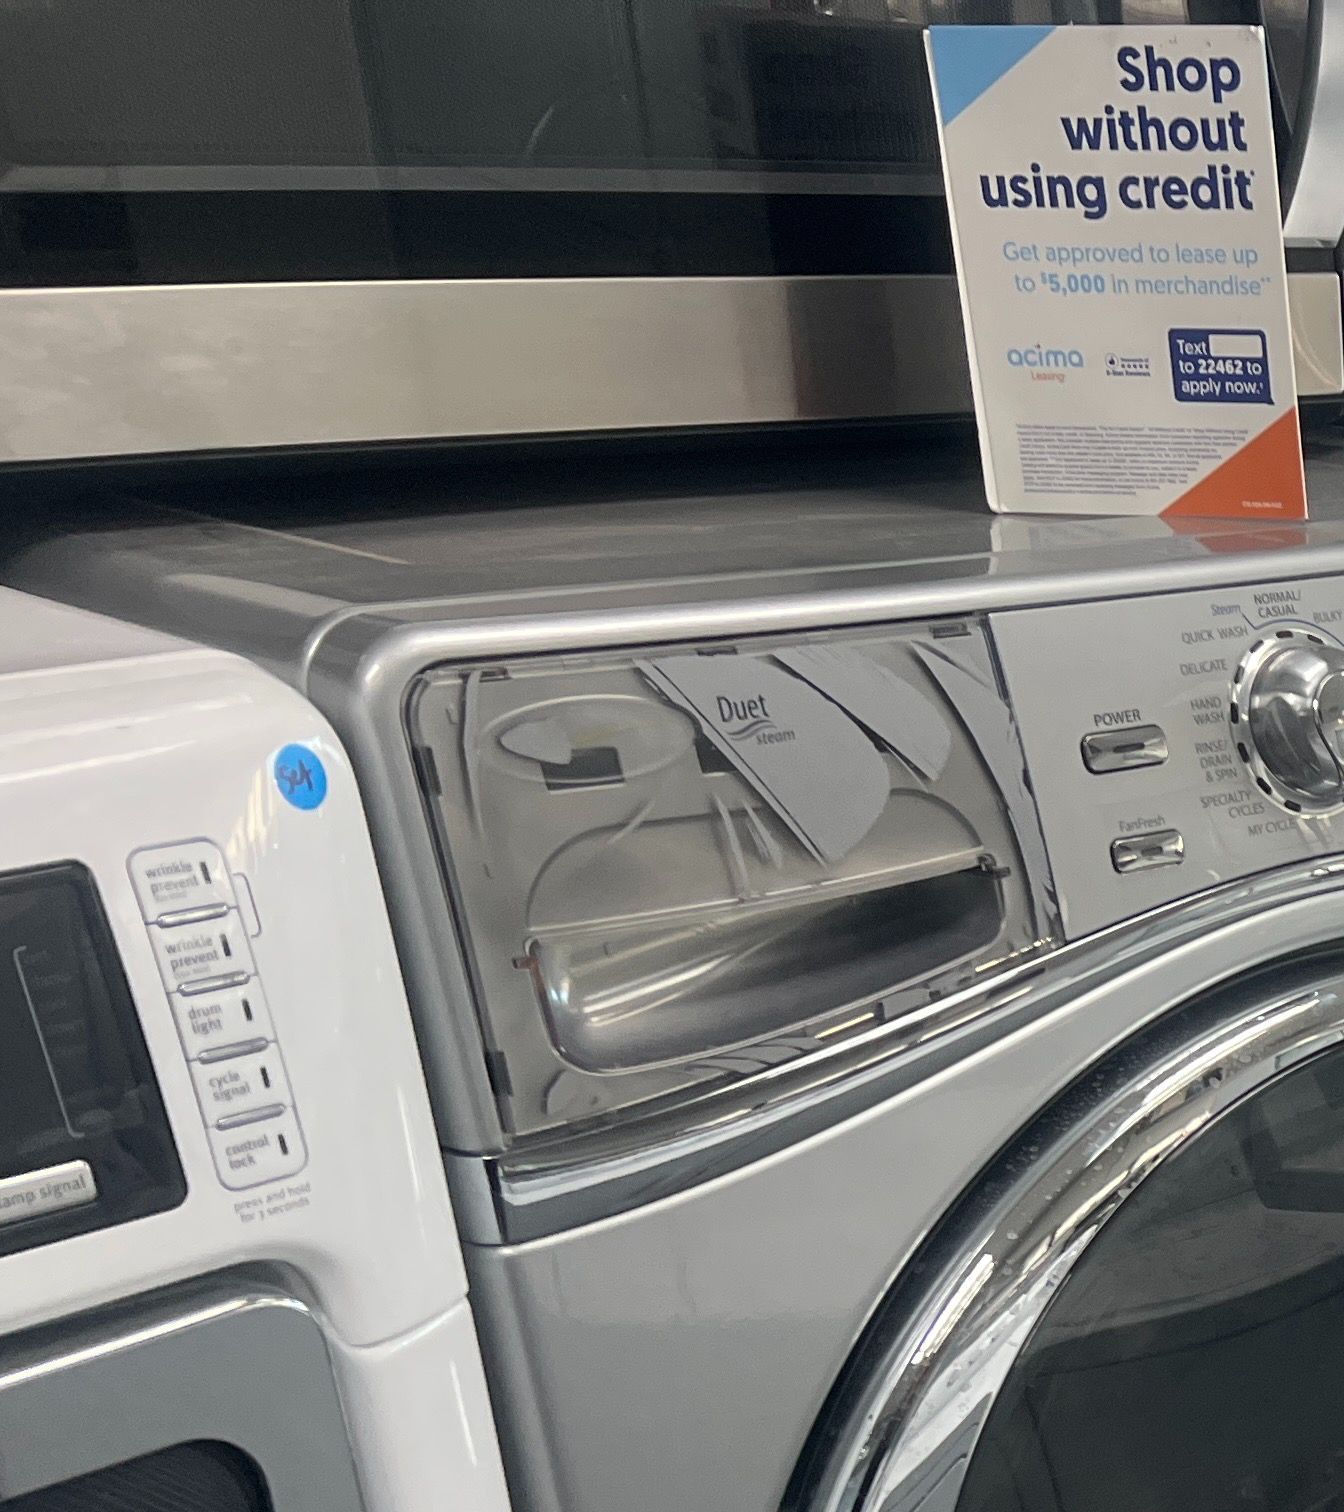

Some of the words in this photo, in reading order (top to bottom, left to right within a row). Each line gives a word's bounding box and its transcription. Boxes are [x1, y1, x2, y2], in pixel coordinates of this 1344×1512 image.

[1117, 45, 1241, 103] Shop
[1060, 104, 1248, 151] without
[979, 162, 1107, 219] using
[1002, 241, 1039, 262] Get
[1045, 243, 1144, 267] approved
[1149, 245, 1170, 263] to
[1175, 243, 1226, 263] lease
[1233, 248, 1258, 268] up
[1015, 273, 1036, 293] to
[1041, 271, 1105, 297] $5,000
[1111, 273, 1129, 293] in
[1007, 344, 1085, 368] acima
[1176, 338, 1209, 356] Text
[1178, 358, 1195, 374] to
[1198, 359, 1243, 375] 22462
[1246, 359, 1262, 375] to
[1030, 372, 1066, 384] Leasing
[1181, 379, 1221, 397] apply
[1210, 604, 1241, 617] Steam
[1258, 604, 1299, 619] CASUAL
[1313, 609, 1342, 623] BULKY
[1181, 629, 1215, 644] QUICK
[1218, 626, 1248, 640] WASH
[1179, 658, 1228, 676] DELICATE
[716, 694, 770, 722] Duet
[1190, 695, 1222, 711] HAND
[1093, 708, 1142, 727] POWER
[1192, 711, 1225, 725] WASH
[756, 730, 796, 745] steam
[1200, 752, 1233, 769] DRAIN
[1214, 766, 1238, 781] SPIN
[1201, 789, 1250, 809] SPECIALTY
[1228, 801, 1265, 819] CYCLES
[1118, 814, 1166, 832] FanFresh
[1247, 823, 1264, 837] MY
[145, 860, 193, 879] wrinkle
[150, 875, 200, 895] prevent
[165, 936, 213, 954] wrinkle
[170, 950, 219, 972] prevent
[188, 1004, 222, 1020] drum
[191, 1018, 223, 1035] light
[209, 1070, 240, 1089] cycle
[212, 1081, 251, 1102] signal
[225, 1134, 270, 1156] control
[0, 1190, 37, 1208] amp
[40, 1172, 87, 1199] signal
